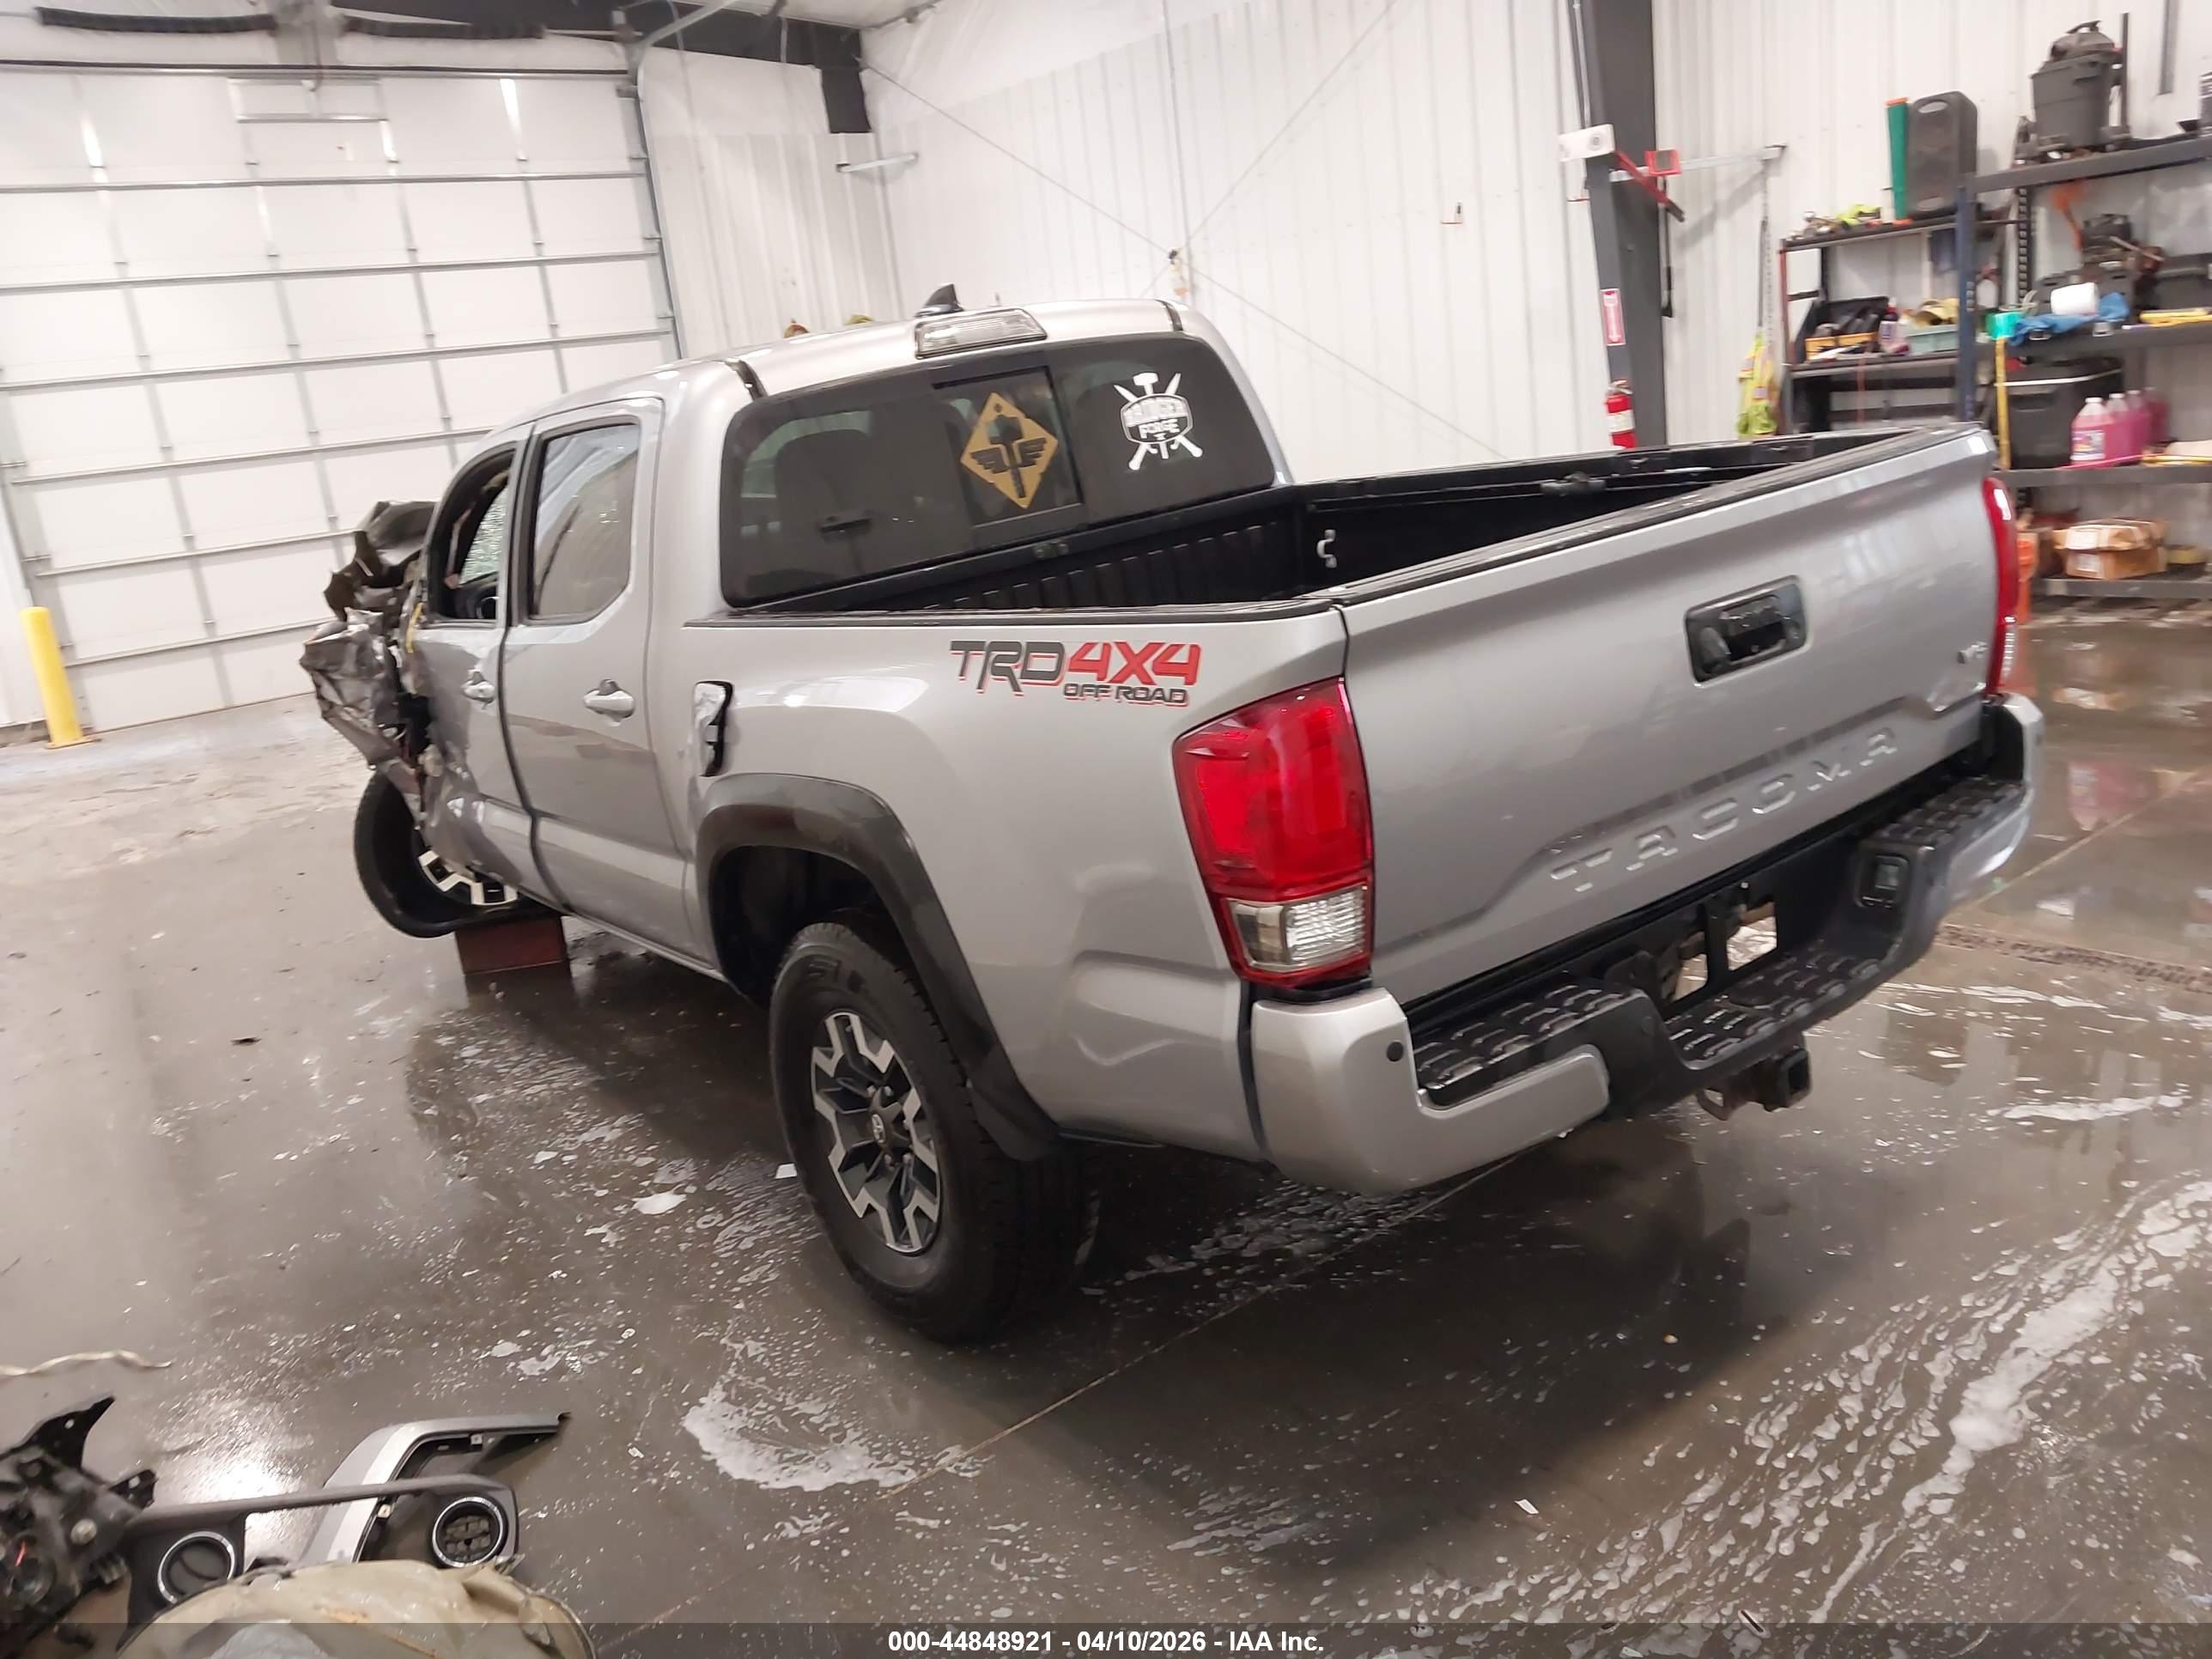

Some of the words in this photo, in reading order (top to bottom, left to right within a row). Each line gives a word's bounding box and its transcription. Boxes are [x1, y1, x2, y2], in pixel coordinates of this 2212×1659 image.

[950, 640, 1066, 696] TRD
[1067, 641, 1201, 686] 4X4
[1062, 683, 1111, 701] OFF
[1115, 687, 1190, 707] ROAD
[1549, 726, 1899, 893] TACOMA
